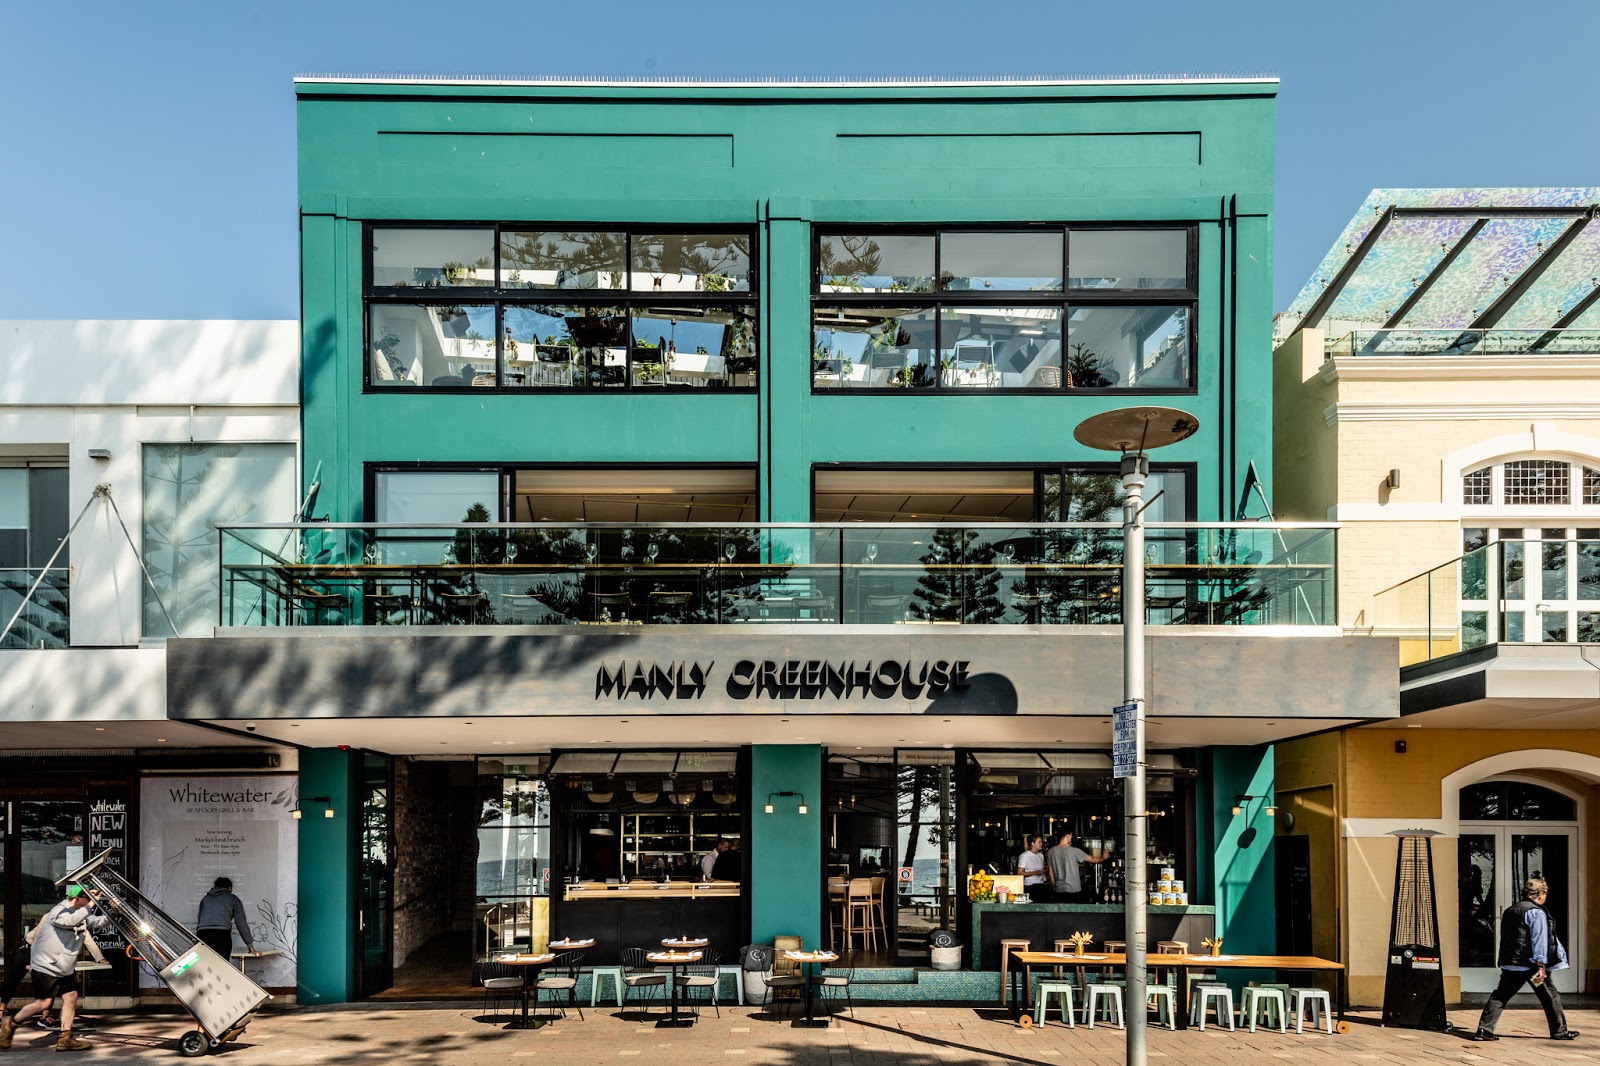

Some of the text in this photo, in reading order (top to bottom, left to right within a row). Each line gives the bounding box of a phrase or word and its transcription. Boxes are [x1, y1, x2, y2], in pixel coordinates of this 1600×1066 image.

[597, 660, 971, 697] MANLY GREENHOUSE
[169, 782, 273, 803] Whitewater
[91, 814, 125, 831] NEW
[91, 833, 123, 848] MENU
[194, 836, 214, 844] Manly's
[227, 835, 246, 843] brunch
